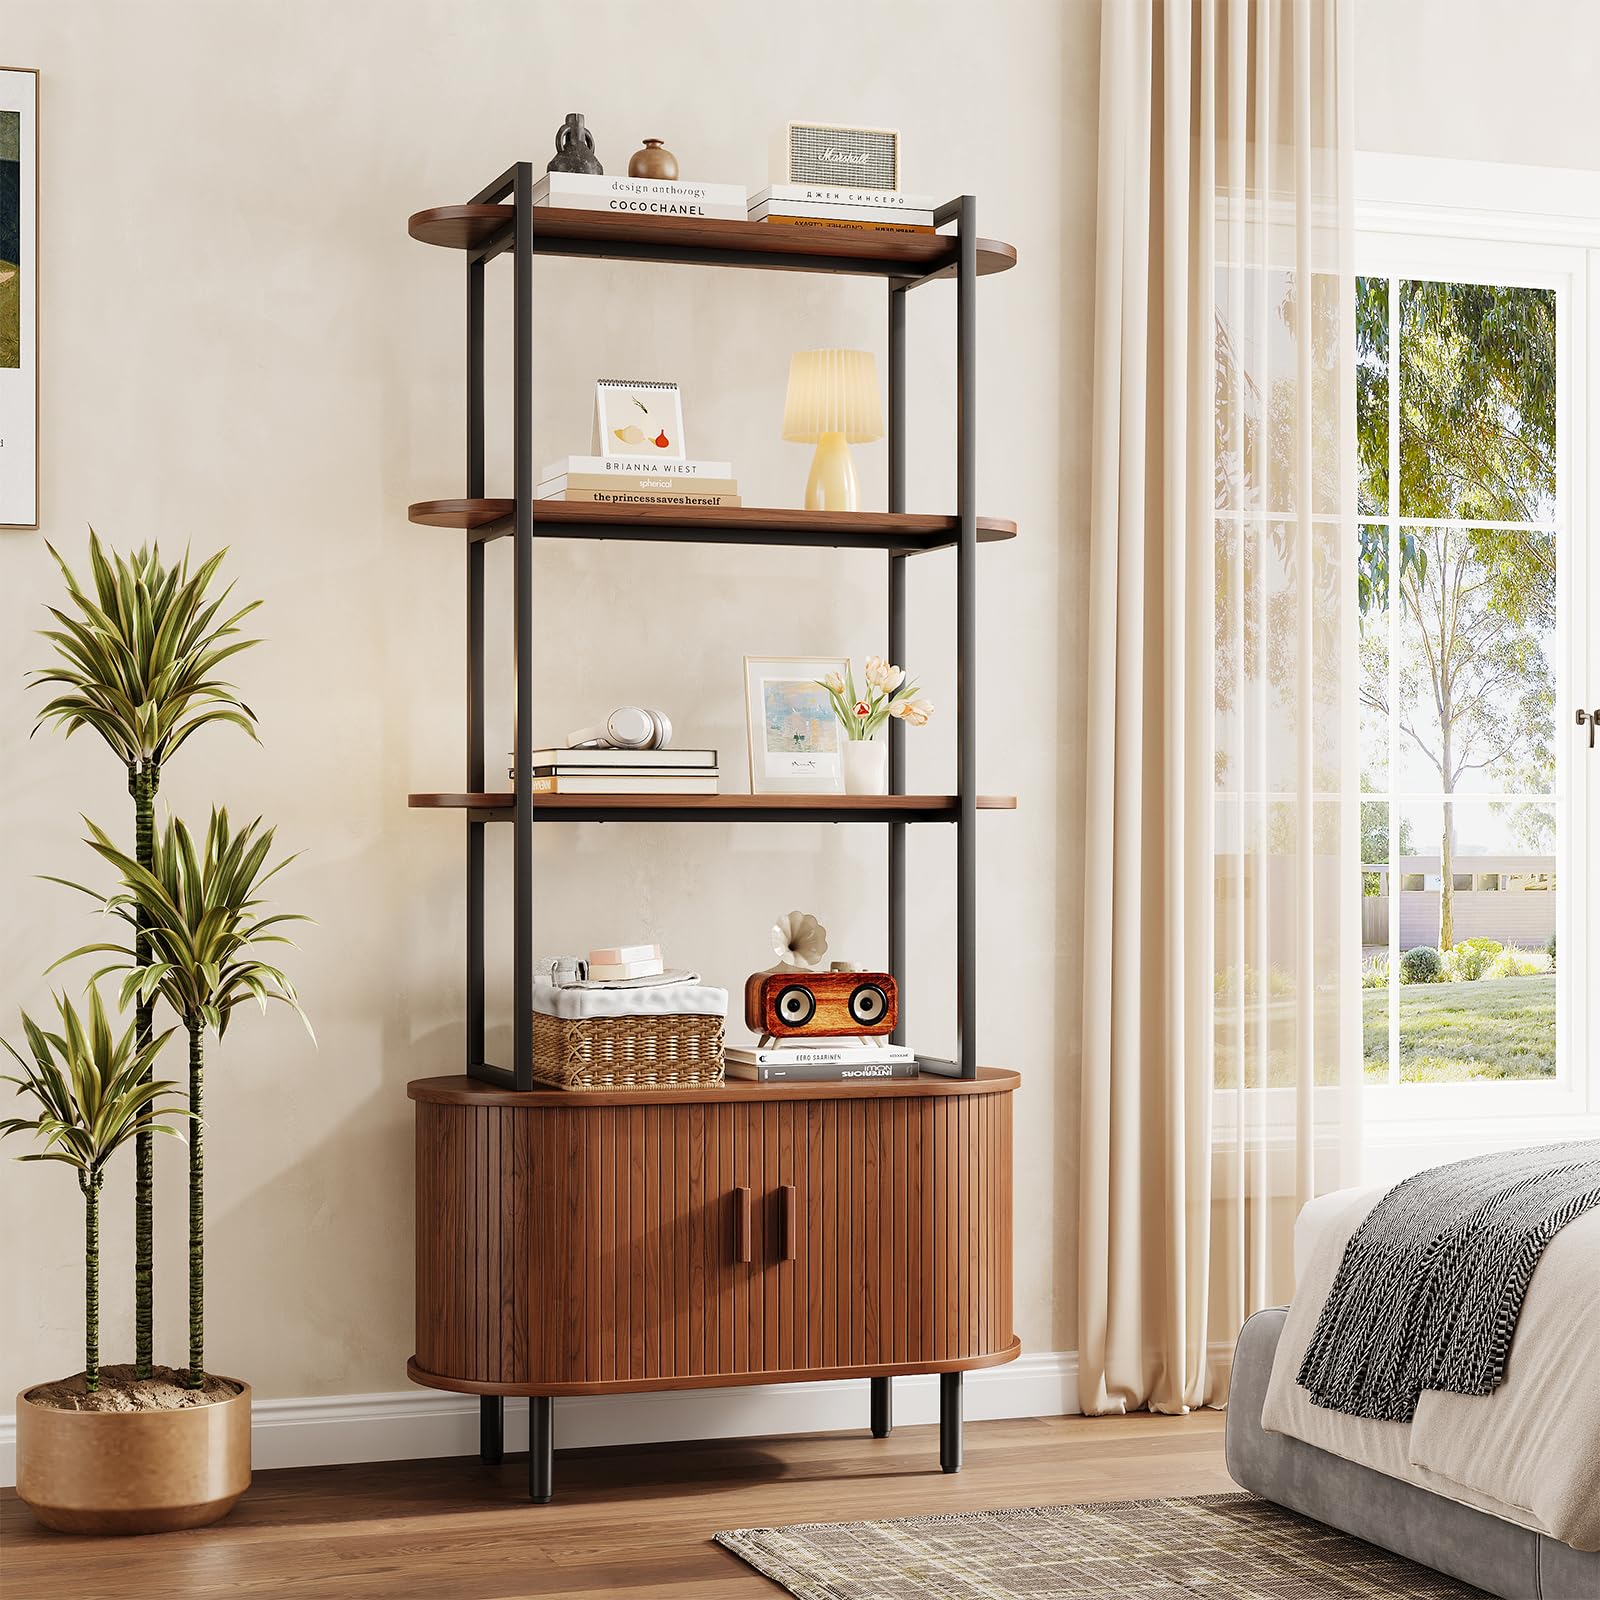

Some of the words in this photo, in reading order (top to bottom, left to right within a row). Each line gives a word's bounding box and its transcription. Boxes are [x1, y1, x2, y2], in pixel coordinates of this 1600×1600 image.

[817, 147, 869, 164] Marshall
[611, 181, 649, 194] design
[652, 185, 706, 199] anthology
[806, 191, 839, 199] ДЖЕН
[848, 194, 904, 204] СИНСЕРО
[605, 462, 658, 472] BRIANNA
[663, 464, 697, 474] WIEST
[593, 493, 611, 501] the
[612, 494, 656, 505] princess
[656, 497, 684, 505] saves
[685, 496, 721, 506] herself
[813, 1053, 841, 1061] SAARINEN
